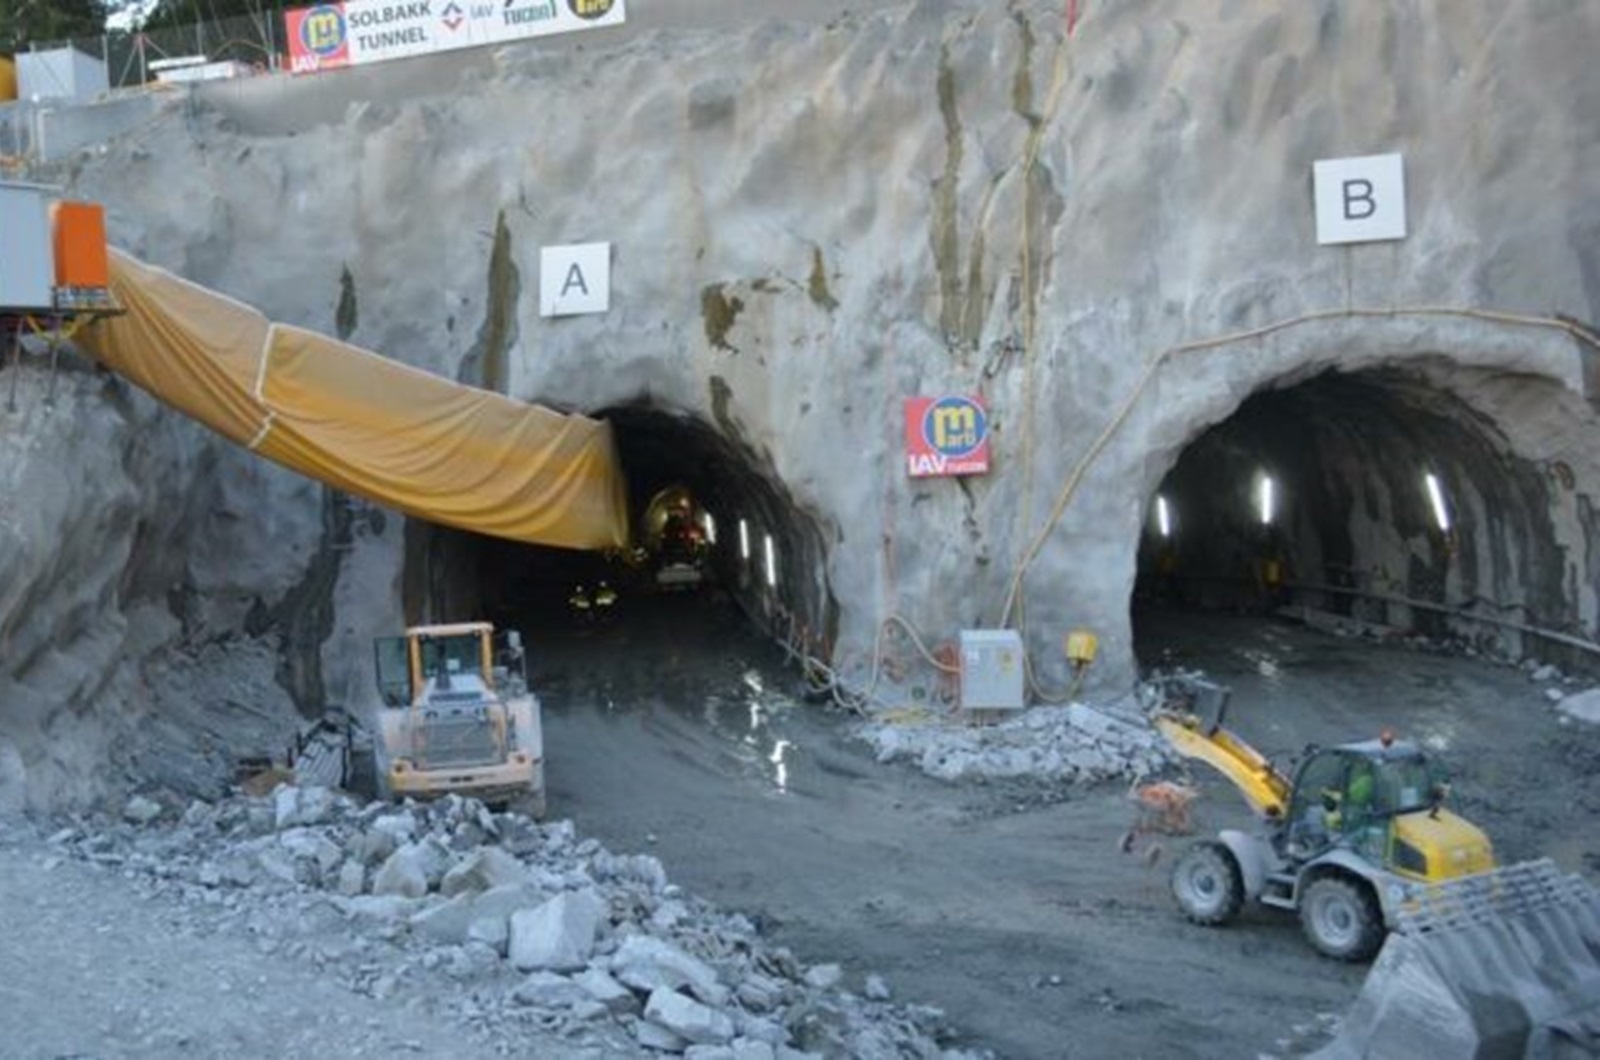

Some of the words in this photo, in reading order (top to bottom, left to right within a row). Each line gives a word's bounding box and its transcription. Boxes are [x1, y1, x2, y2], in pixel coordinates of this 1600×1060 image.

[348, 1, 431, 28] SOLBAKK
[358, 27, 428, 50] TUNNEL
[1342, 179, 1377, 220] B
[561, 262, 588, 297] A
[908, 453, 947, 477] IAV
